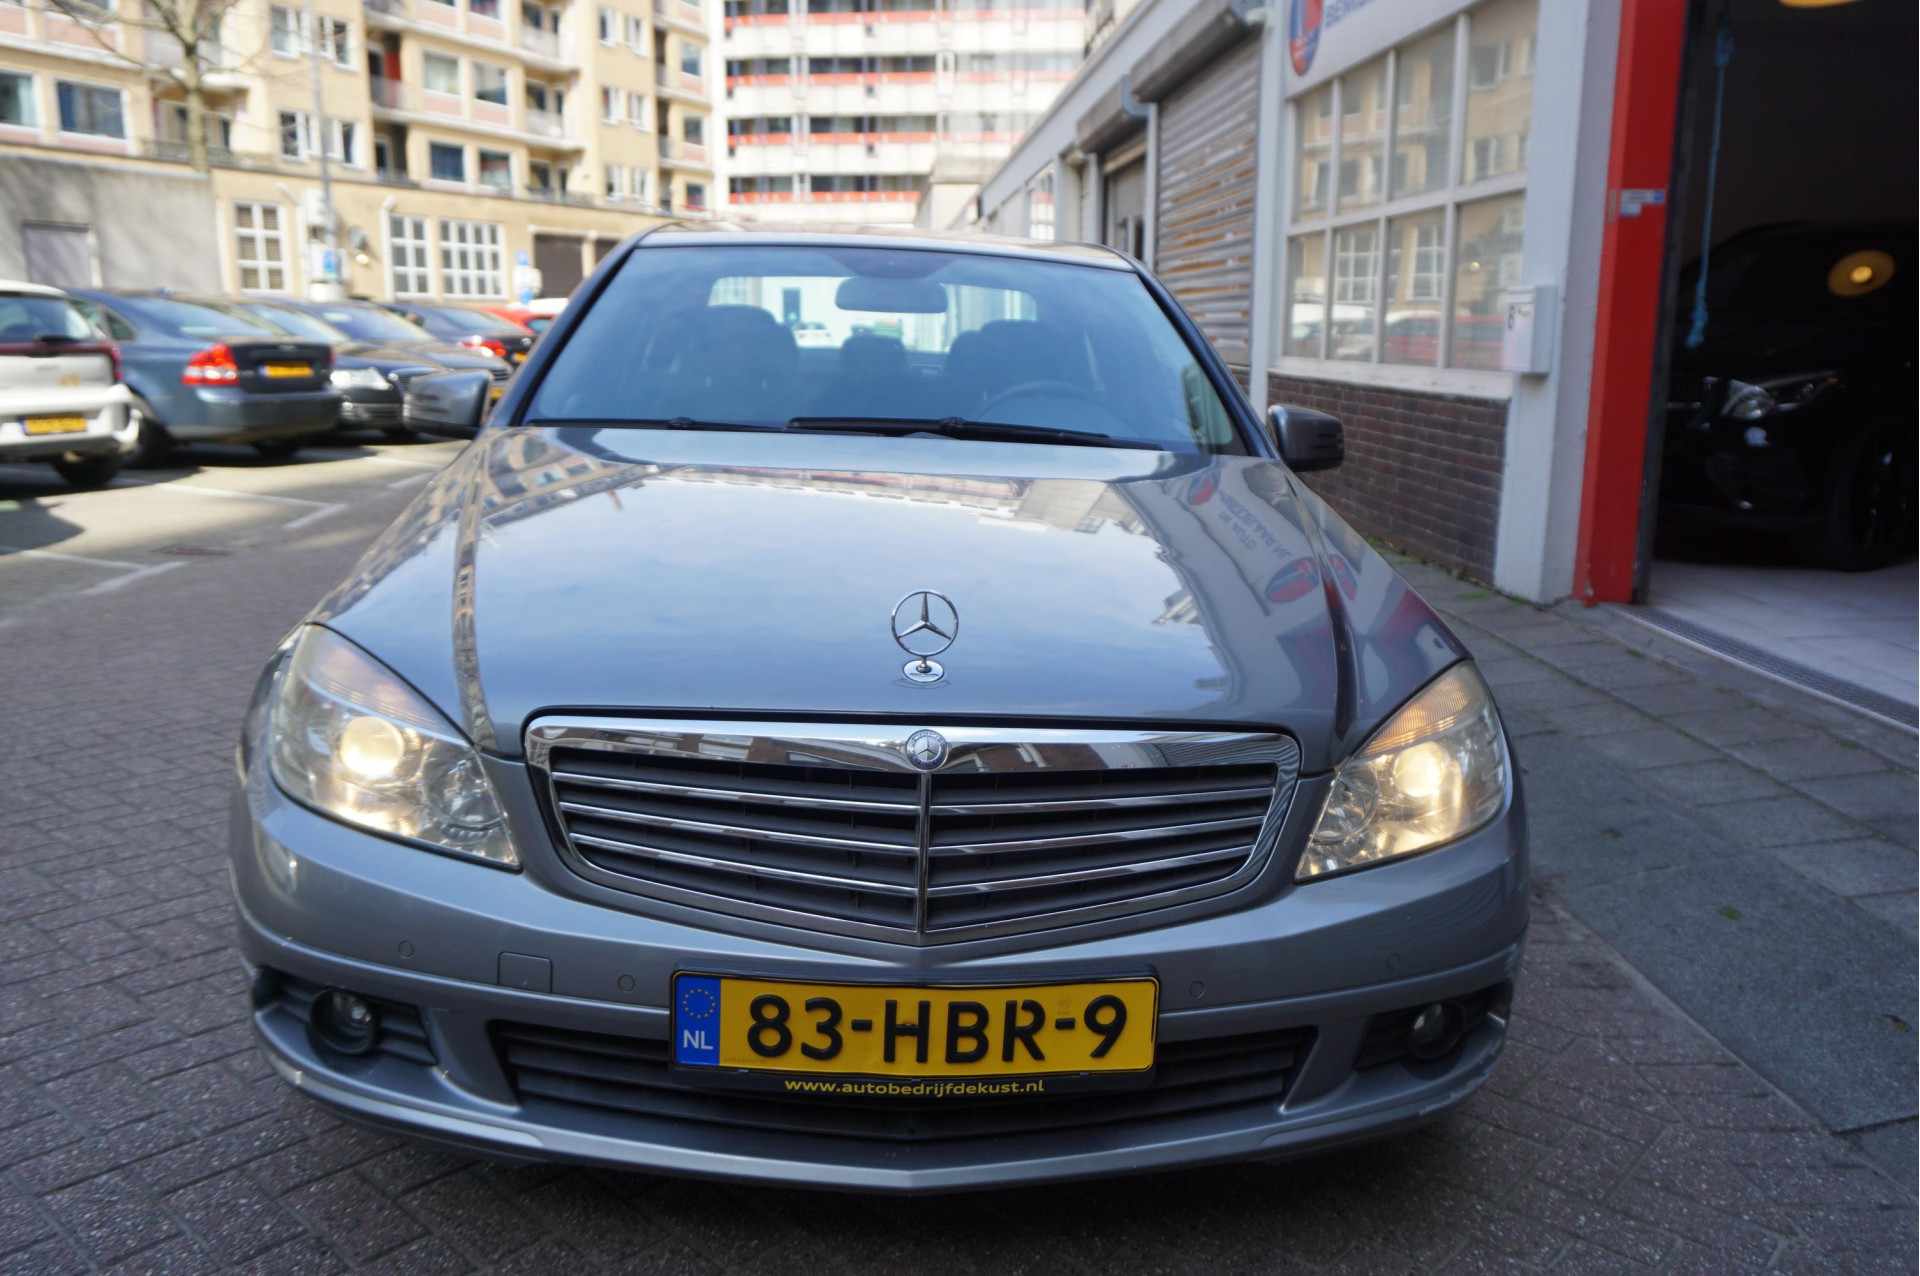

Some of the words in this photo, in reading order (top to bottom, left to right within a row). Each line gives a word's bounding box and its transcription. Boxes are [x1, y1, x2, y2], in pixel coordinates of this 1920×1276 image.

[747, 993, 1128, 1064] 83-HBR-9
[683, 1029, 714, 1050] NL
[784, 1079, 1045, 1098] www.autobedrijfdekust.nl
